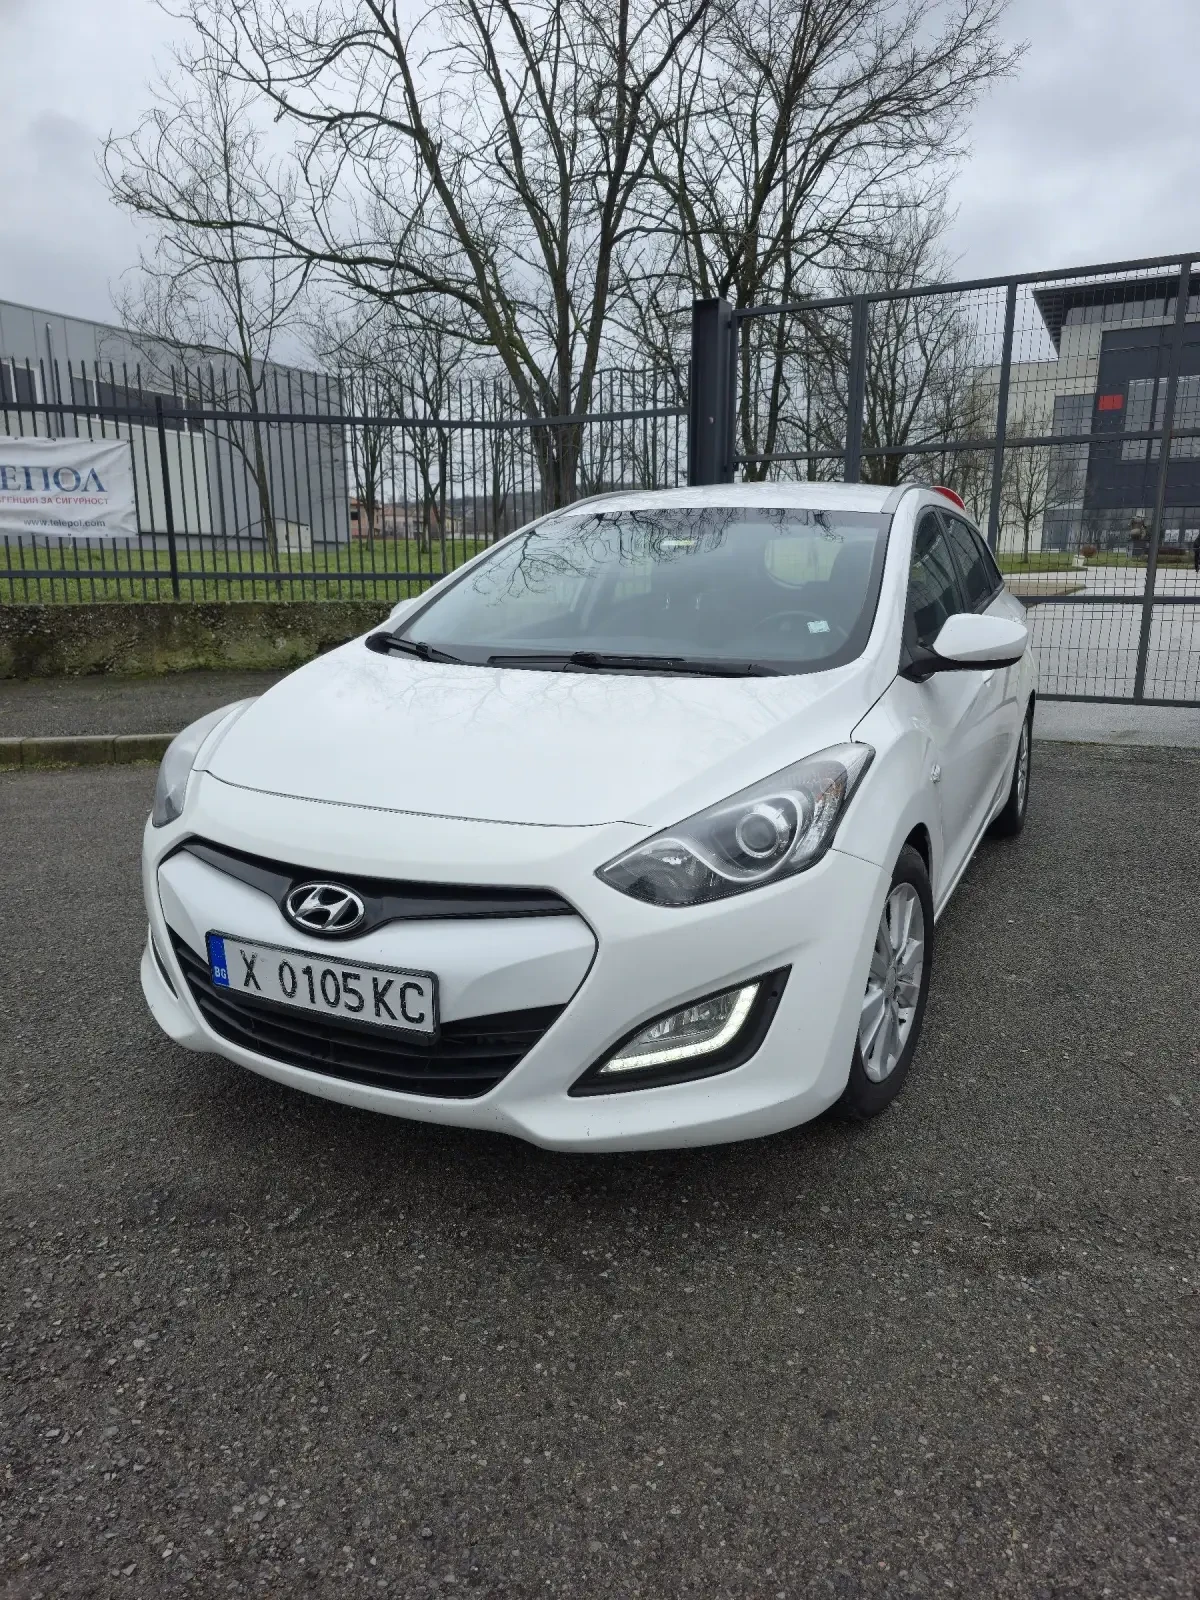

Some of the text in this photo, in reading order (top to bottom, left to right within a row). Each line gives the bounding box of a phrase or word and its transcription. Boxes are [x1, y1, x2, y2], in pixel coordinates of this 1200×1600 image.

[0, 496, 38, 504] ГЕНЦИЯ
[55, 497, 108, 505] СИГУРНОСТ
[23, 519, 106, 528] www.telepol.com
[214, 965, 227, 980] BG
